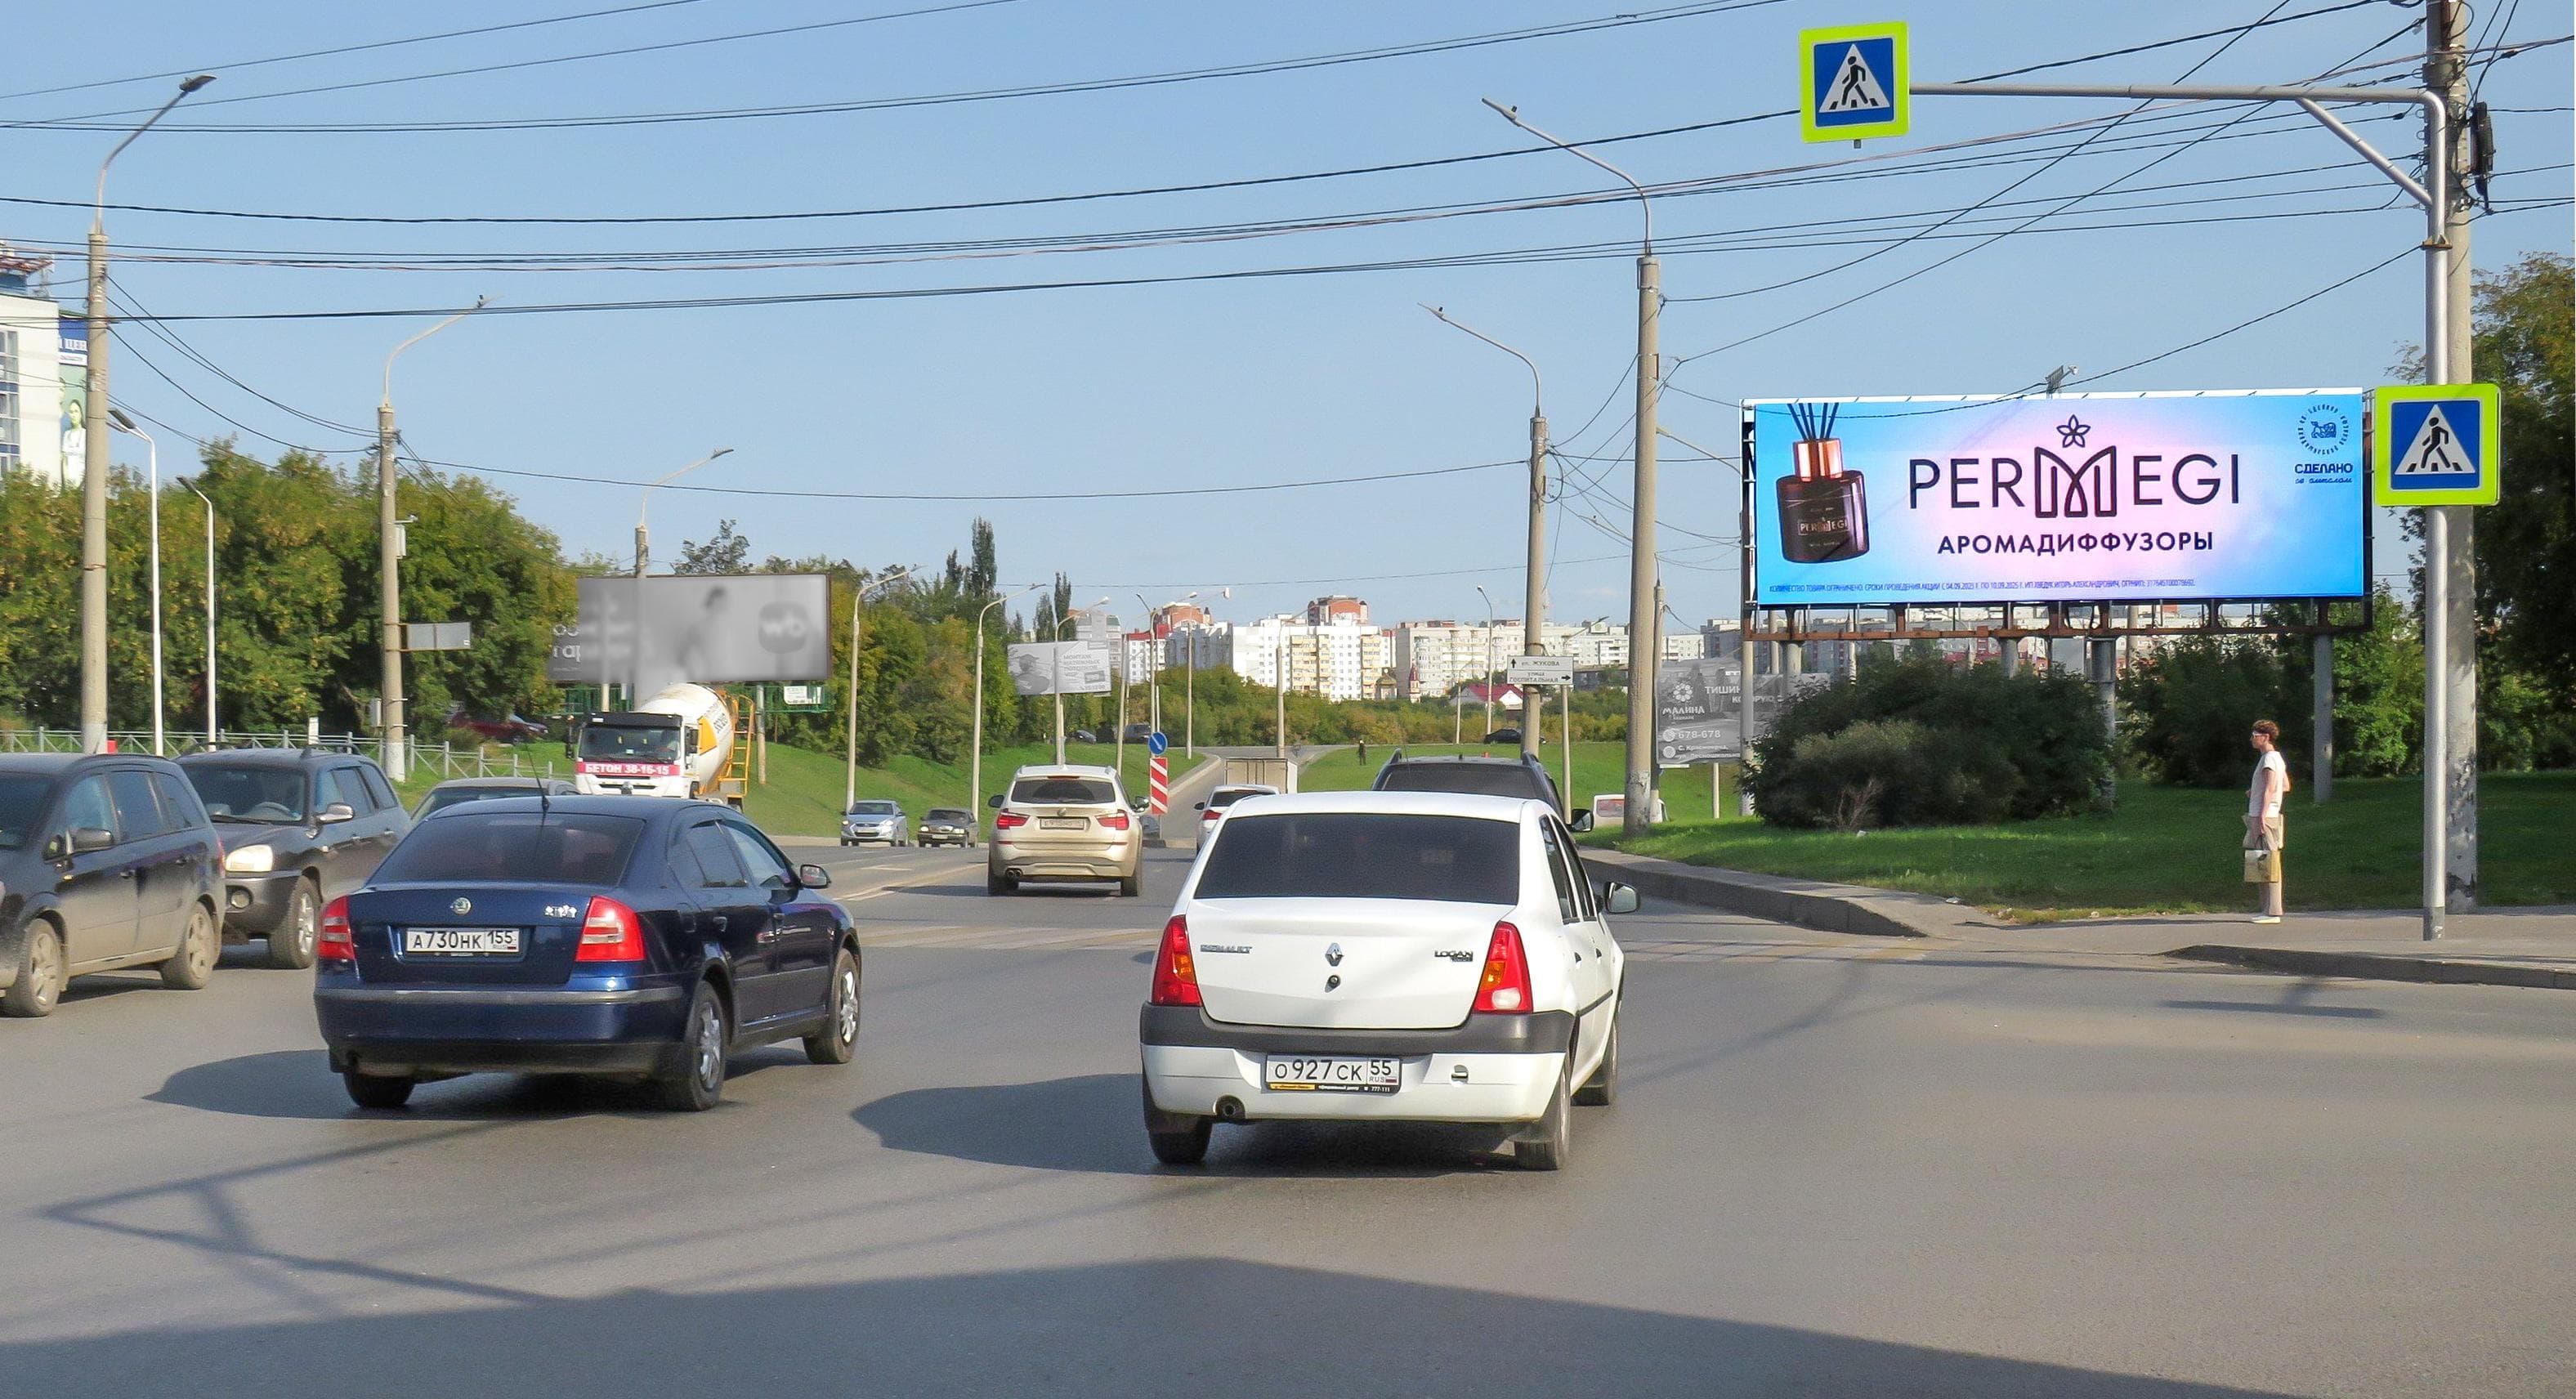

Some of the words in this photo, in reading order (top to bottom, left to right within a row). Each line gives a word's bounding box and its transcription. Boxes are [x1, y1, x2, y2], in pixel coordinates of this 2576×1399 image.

[2294, 463, 2353, 474] СДЕЛАНО
[1908, 445, 2239, 518] PERMEGI
[1938, 531, 2214, 556] АРОМАДИФФУЗОРЫ
[1662, 706, 1706, 714] МАЛИНА
[1678, 730, 1721, 739] 678-678
[585, 763, 621, 773] БЕТОН
[624, 765, 669, 775] 38-16-15
[413, 932, 482, 949] А730НК
[488, 931, 513, 944] 155
[1275, 1060, 1362, 1081] О927СК
[1370, 1060, 1392, 1075] 55
